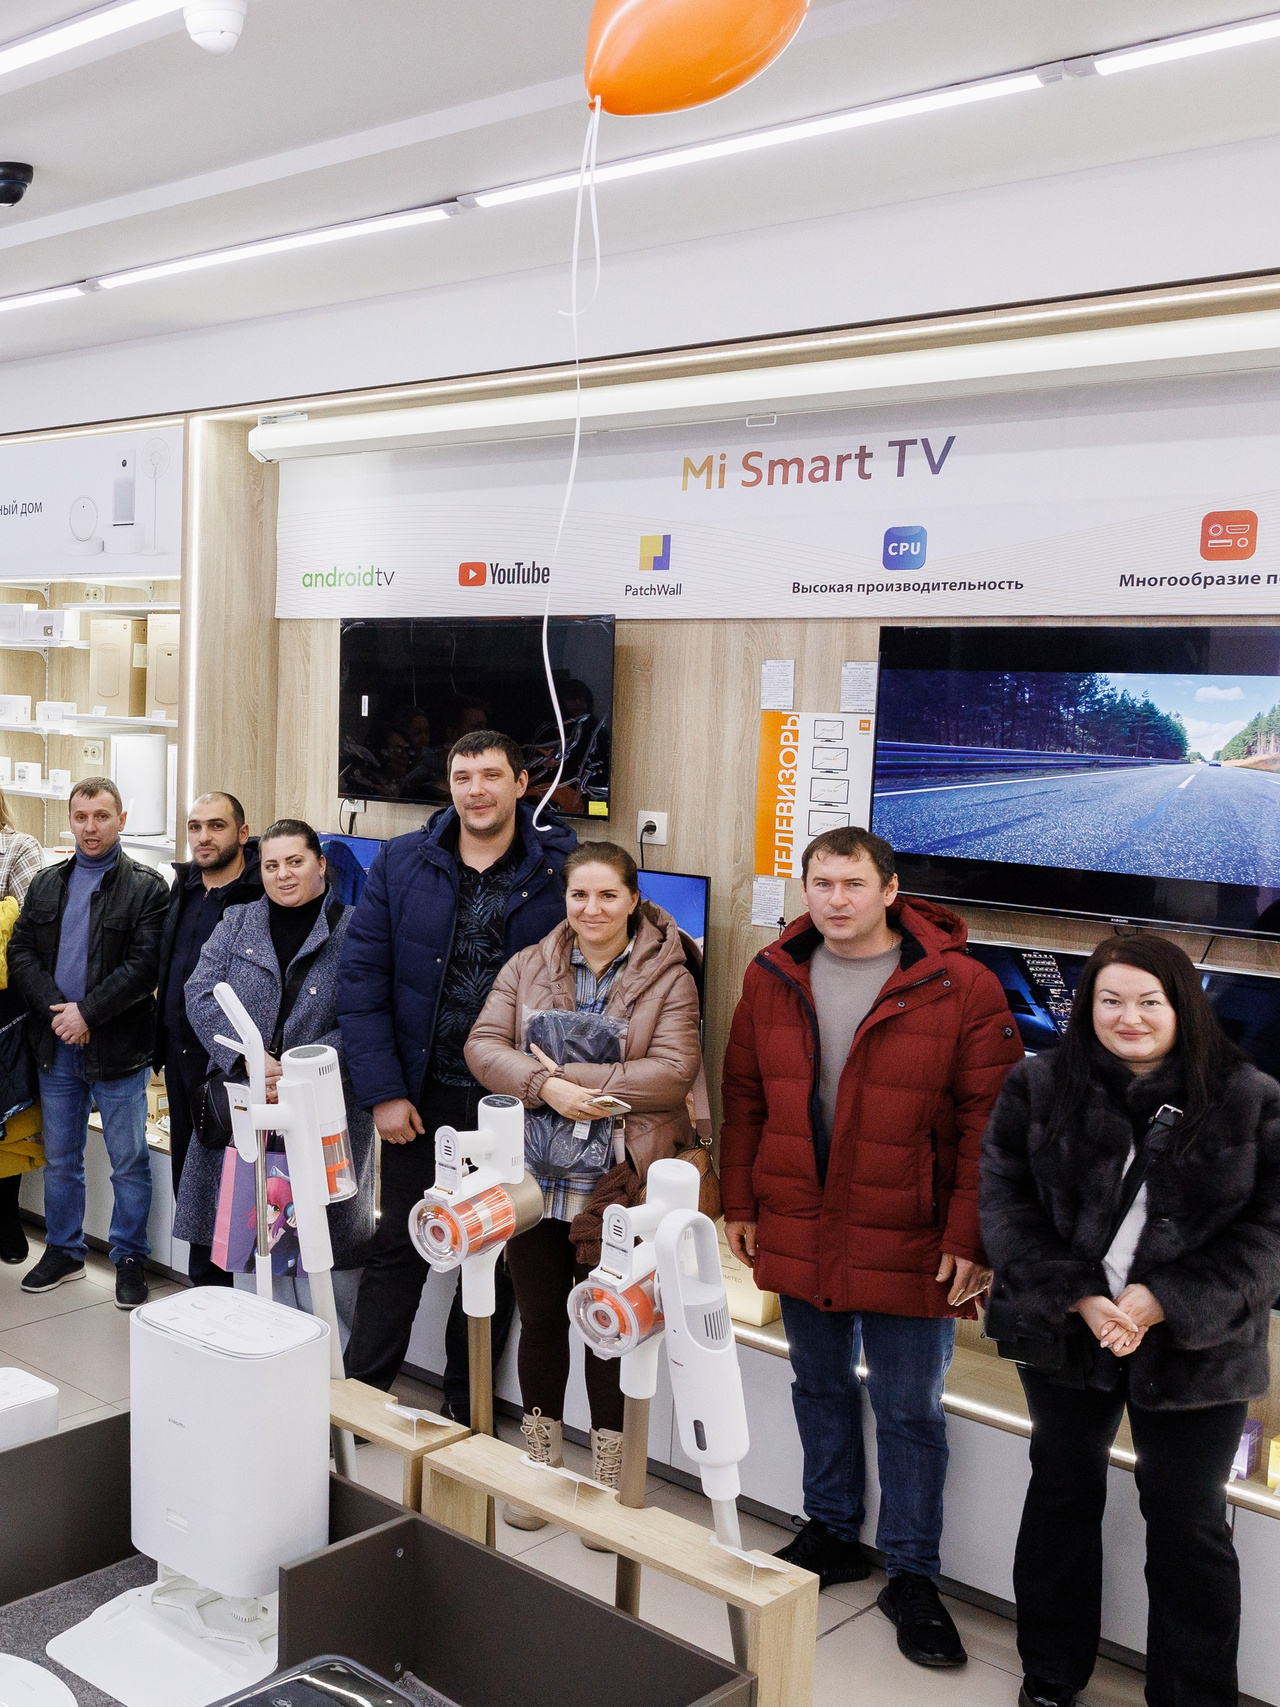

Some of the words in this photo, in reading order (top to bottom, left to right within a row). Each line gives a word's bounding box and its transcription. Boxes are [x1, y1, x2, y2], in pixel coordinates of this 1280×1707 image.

[681, 452, 727, 491] Mi
[740, 444, 874, 488] Smart
[887, 435, 956, 478] TV
[20, 502, 43, 517] дом
[887, 541, 921, 556] CPU
[489, 561, 551, 585] YouTube
[1119, 571, 1262, 589] Многообразие
[1266, 573, 1280, 585] п
[624, 582, 683, 597] PatchWall
[791, 581, 854, 595] Высокая
[856, 577, 1025, 596] производительность
[773, 711, 801, 878] ТЕЛЕВИЗОРЫ
[722, 1273, 743, 1285] IMITED
